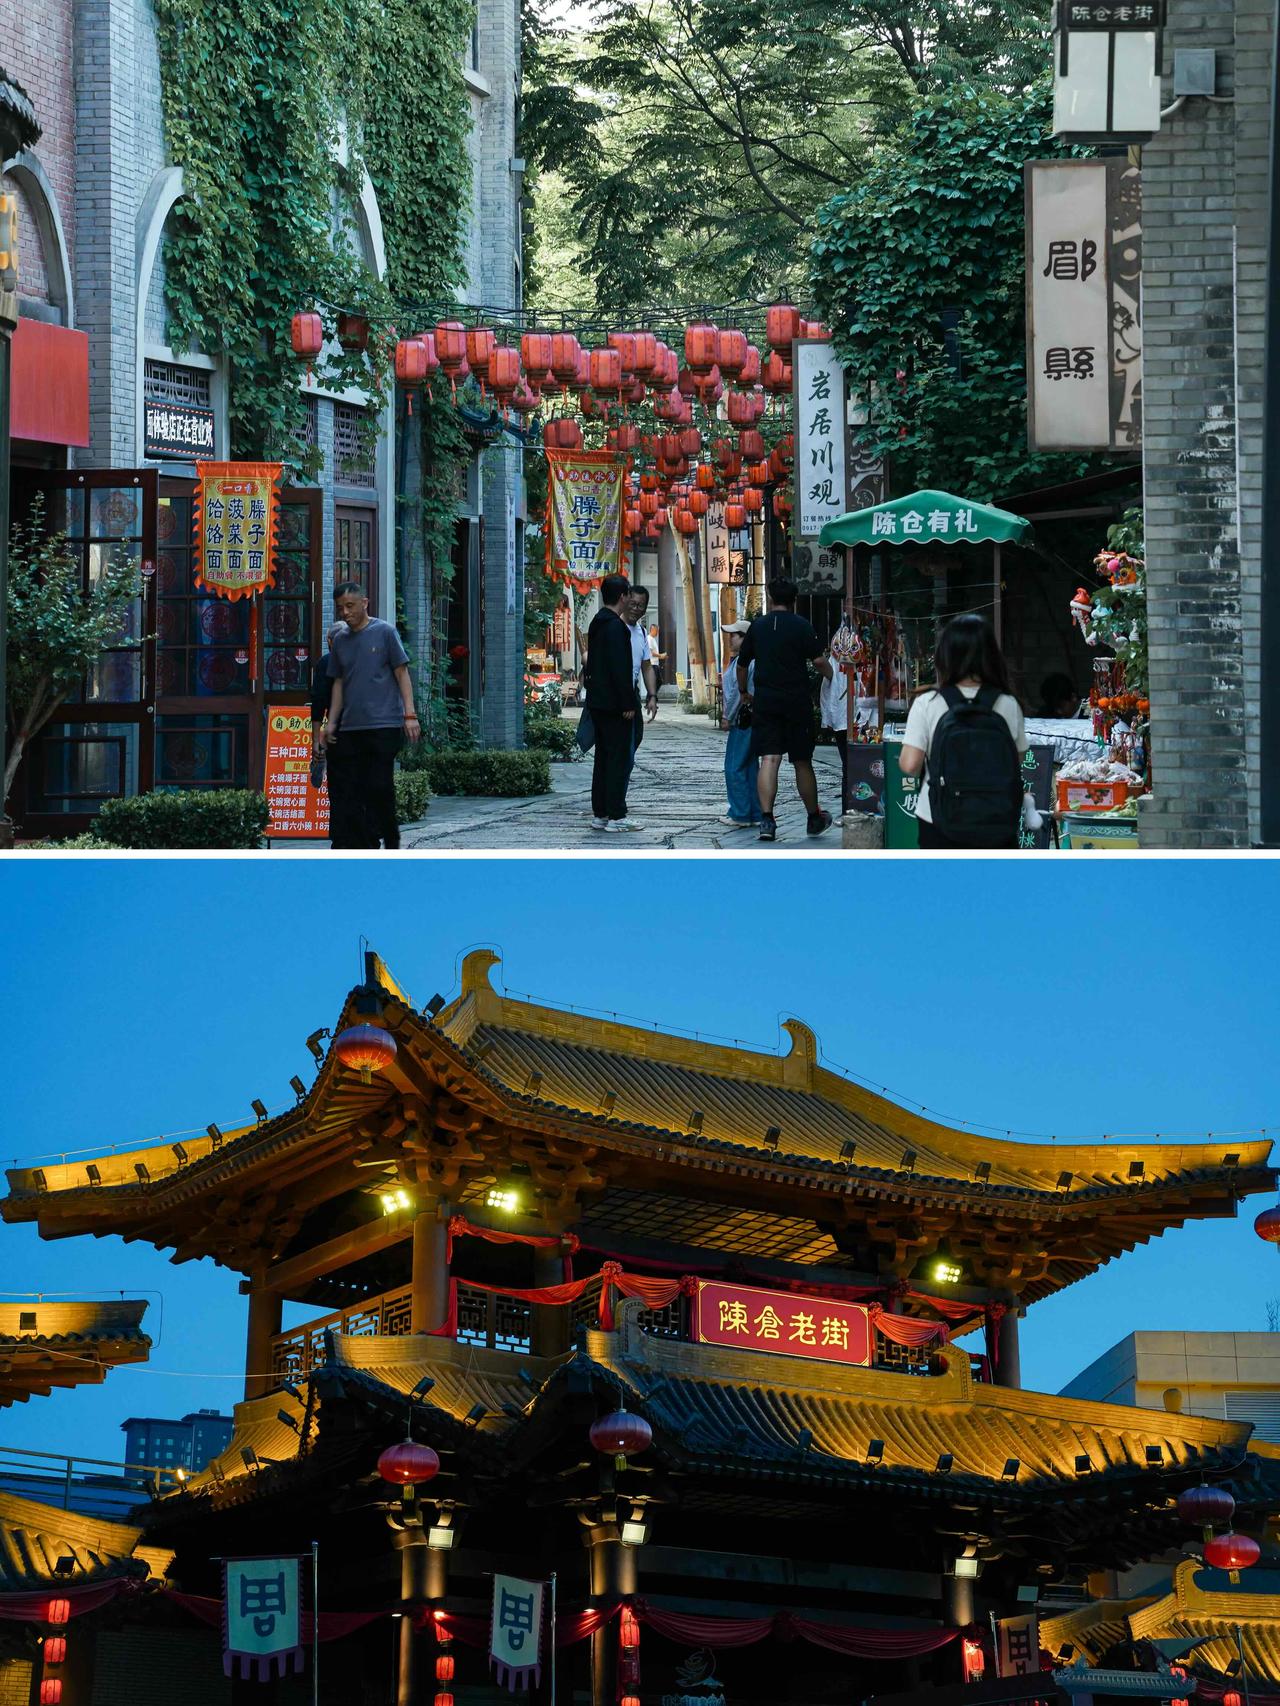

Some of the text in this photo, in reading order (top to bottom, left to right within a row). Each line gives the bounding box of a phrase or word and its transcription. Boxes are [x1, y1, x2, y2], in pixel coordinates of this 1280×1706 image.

[1072, 5, 1153, 21] 陈仓老街
[808, 370, 840, 506] 岩居川观
[223, 483, 252, 494] 一口香
[569, 495, 601, 559] 臊子面
[872, 508, 978, 535] 陈仓有礼
[719, 1300, 850, 1350] 陳倉老街
